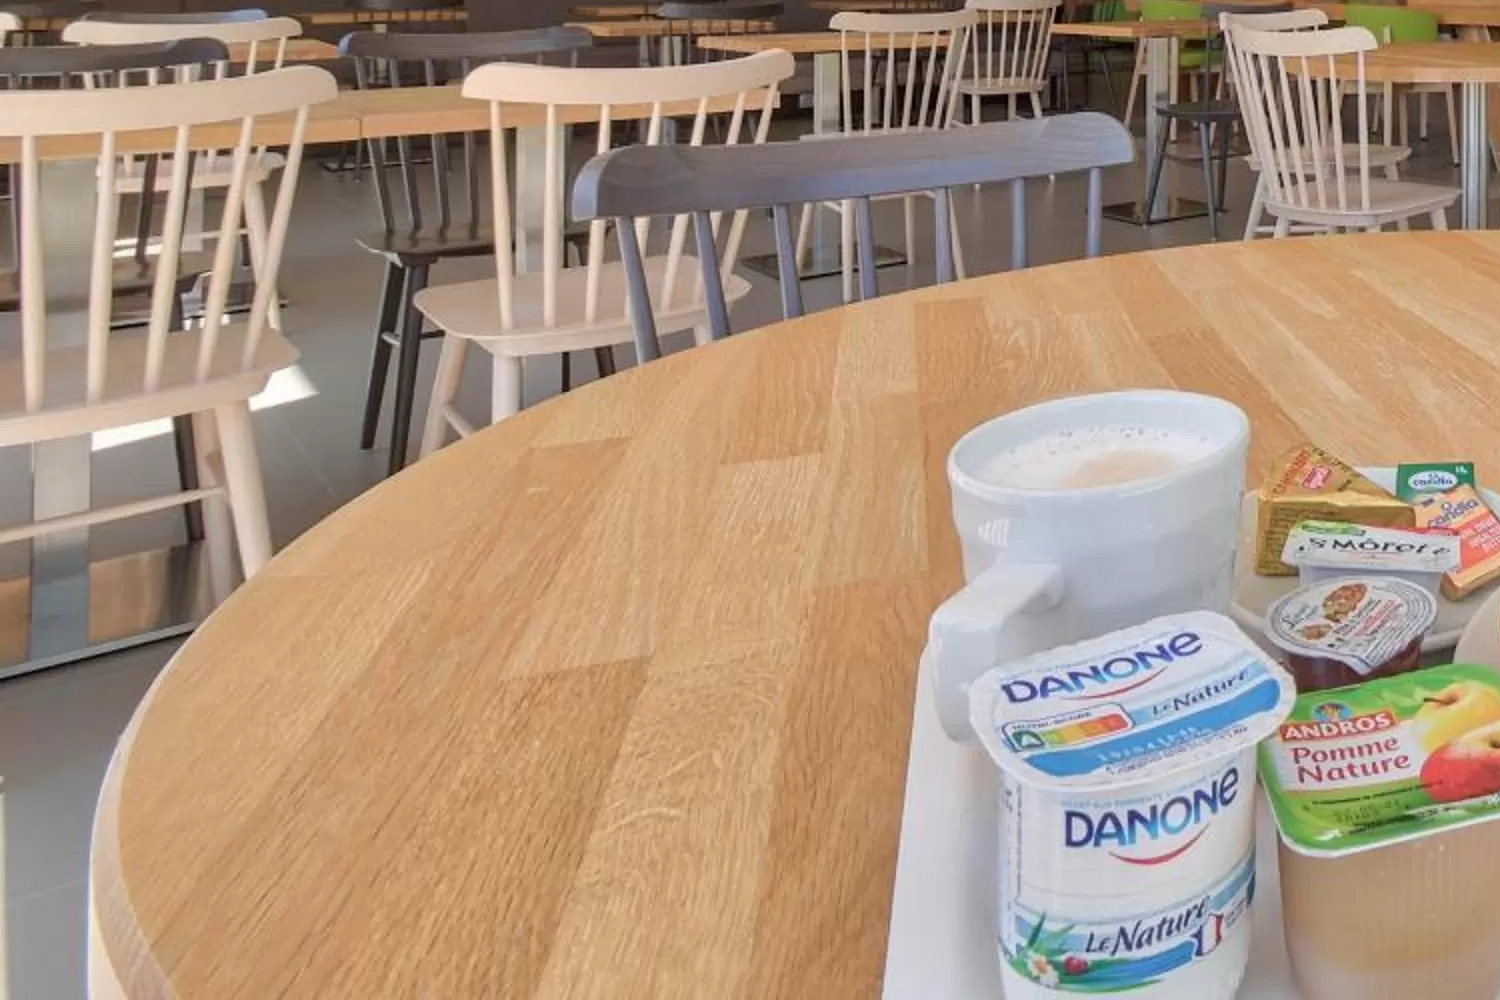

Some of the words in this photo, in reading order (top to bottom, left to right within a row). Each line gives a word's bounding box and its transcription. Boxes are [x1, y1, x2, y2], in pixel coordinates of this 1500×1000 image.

[1172, 669, 1250, 712] Nature
[1285, 712, 1391, 740] ANDROS
[1290, 737, 1400, 765] Pomme
[1297, 755, 1411, 784] Nature
[1111, 895, 1211, 957] Nature
